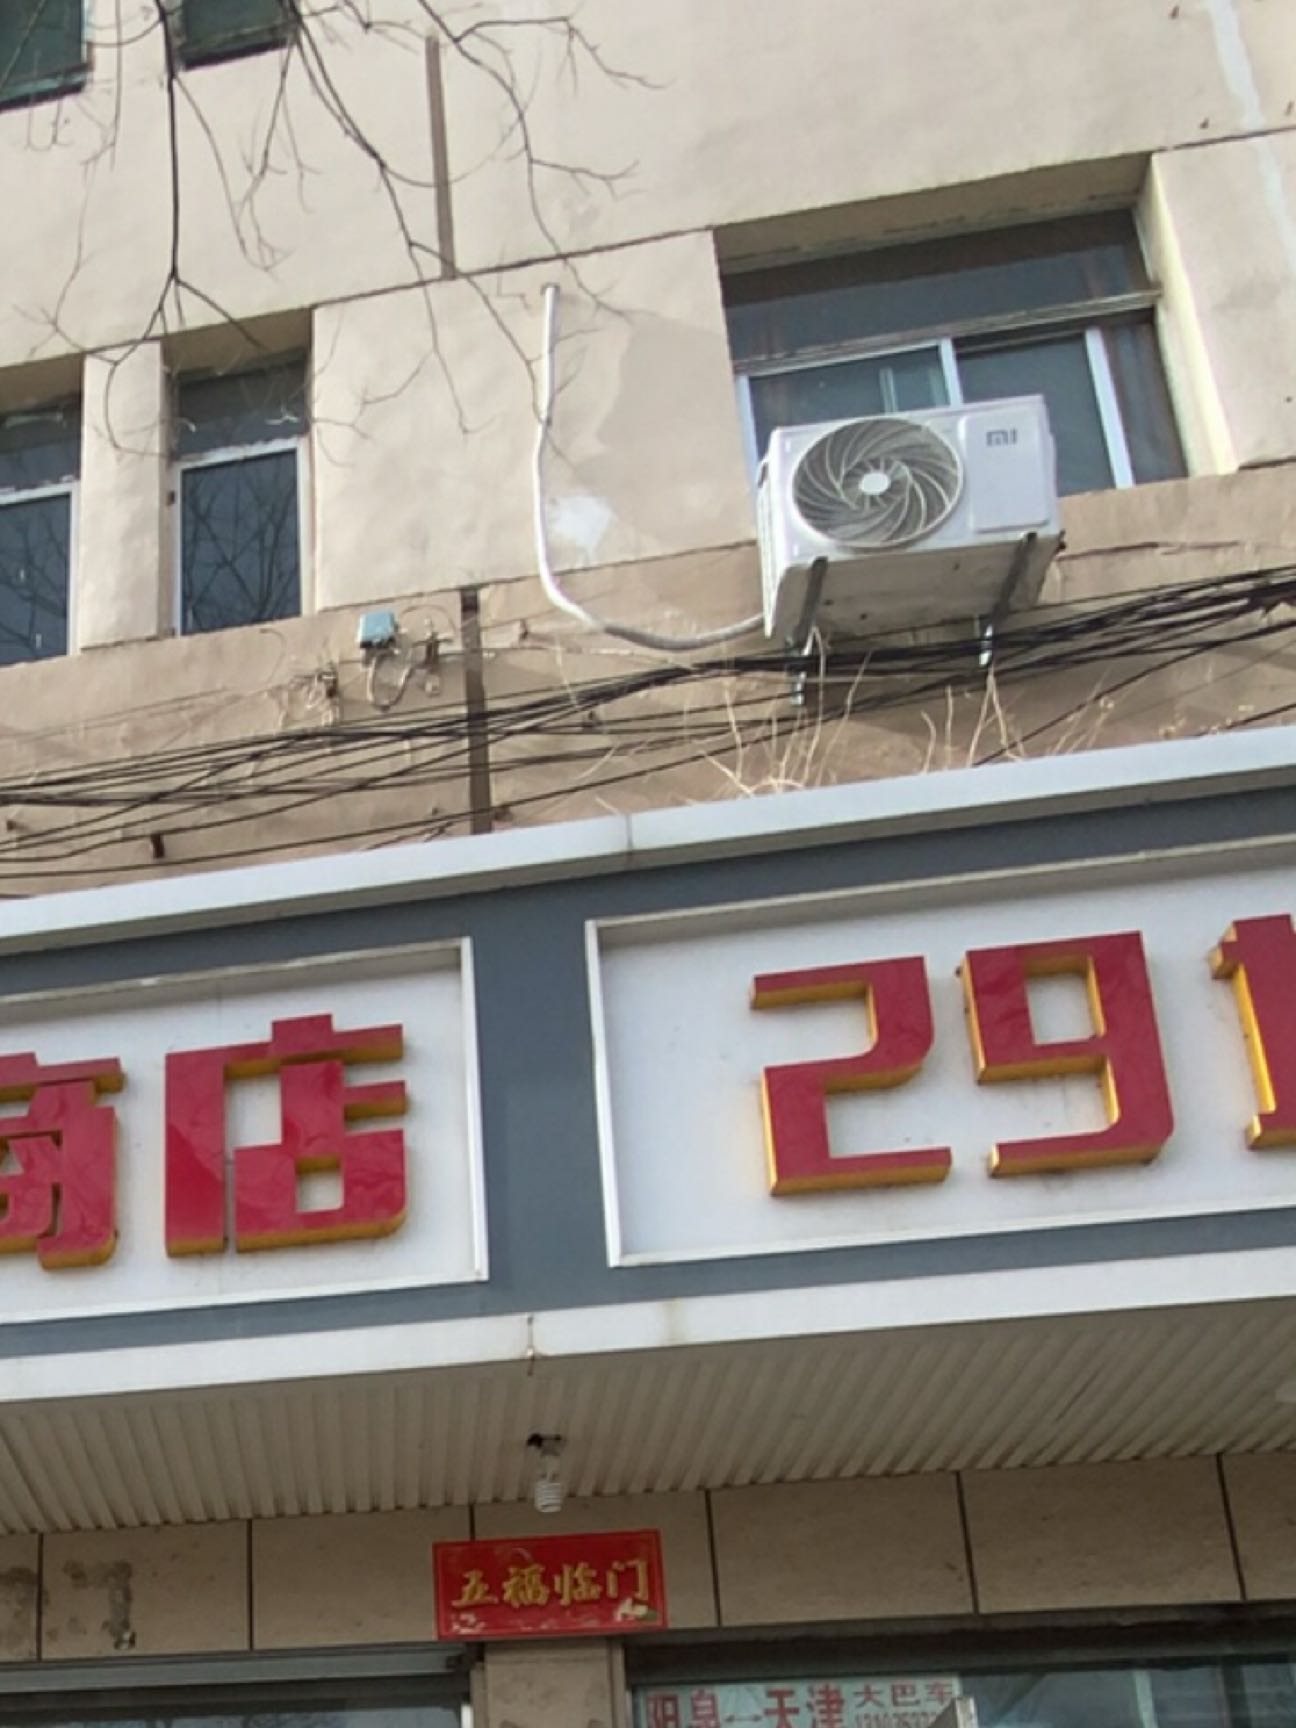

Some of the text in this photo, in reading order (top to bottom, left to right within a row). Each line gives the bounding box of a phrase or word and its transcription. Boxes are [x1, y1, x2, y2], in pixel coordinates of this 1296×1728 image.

[451, 1558, 650, 1608] 五福临门
[853, 1681, 954, 1711] 大巴车
